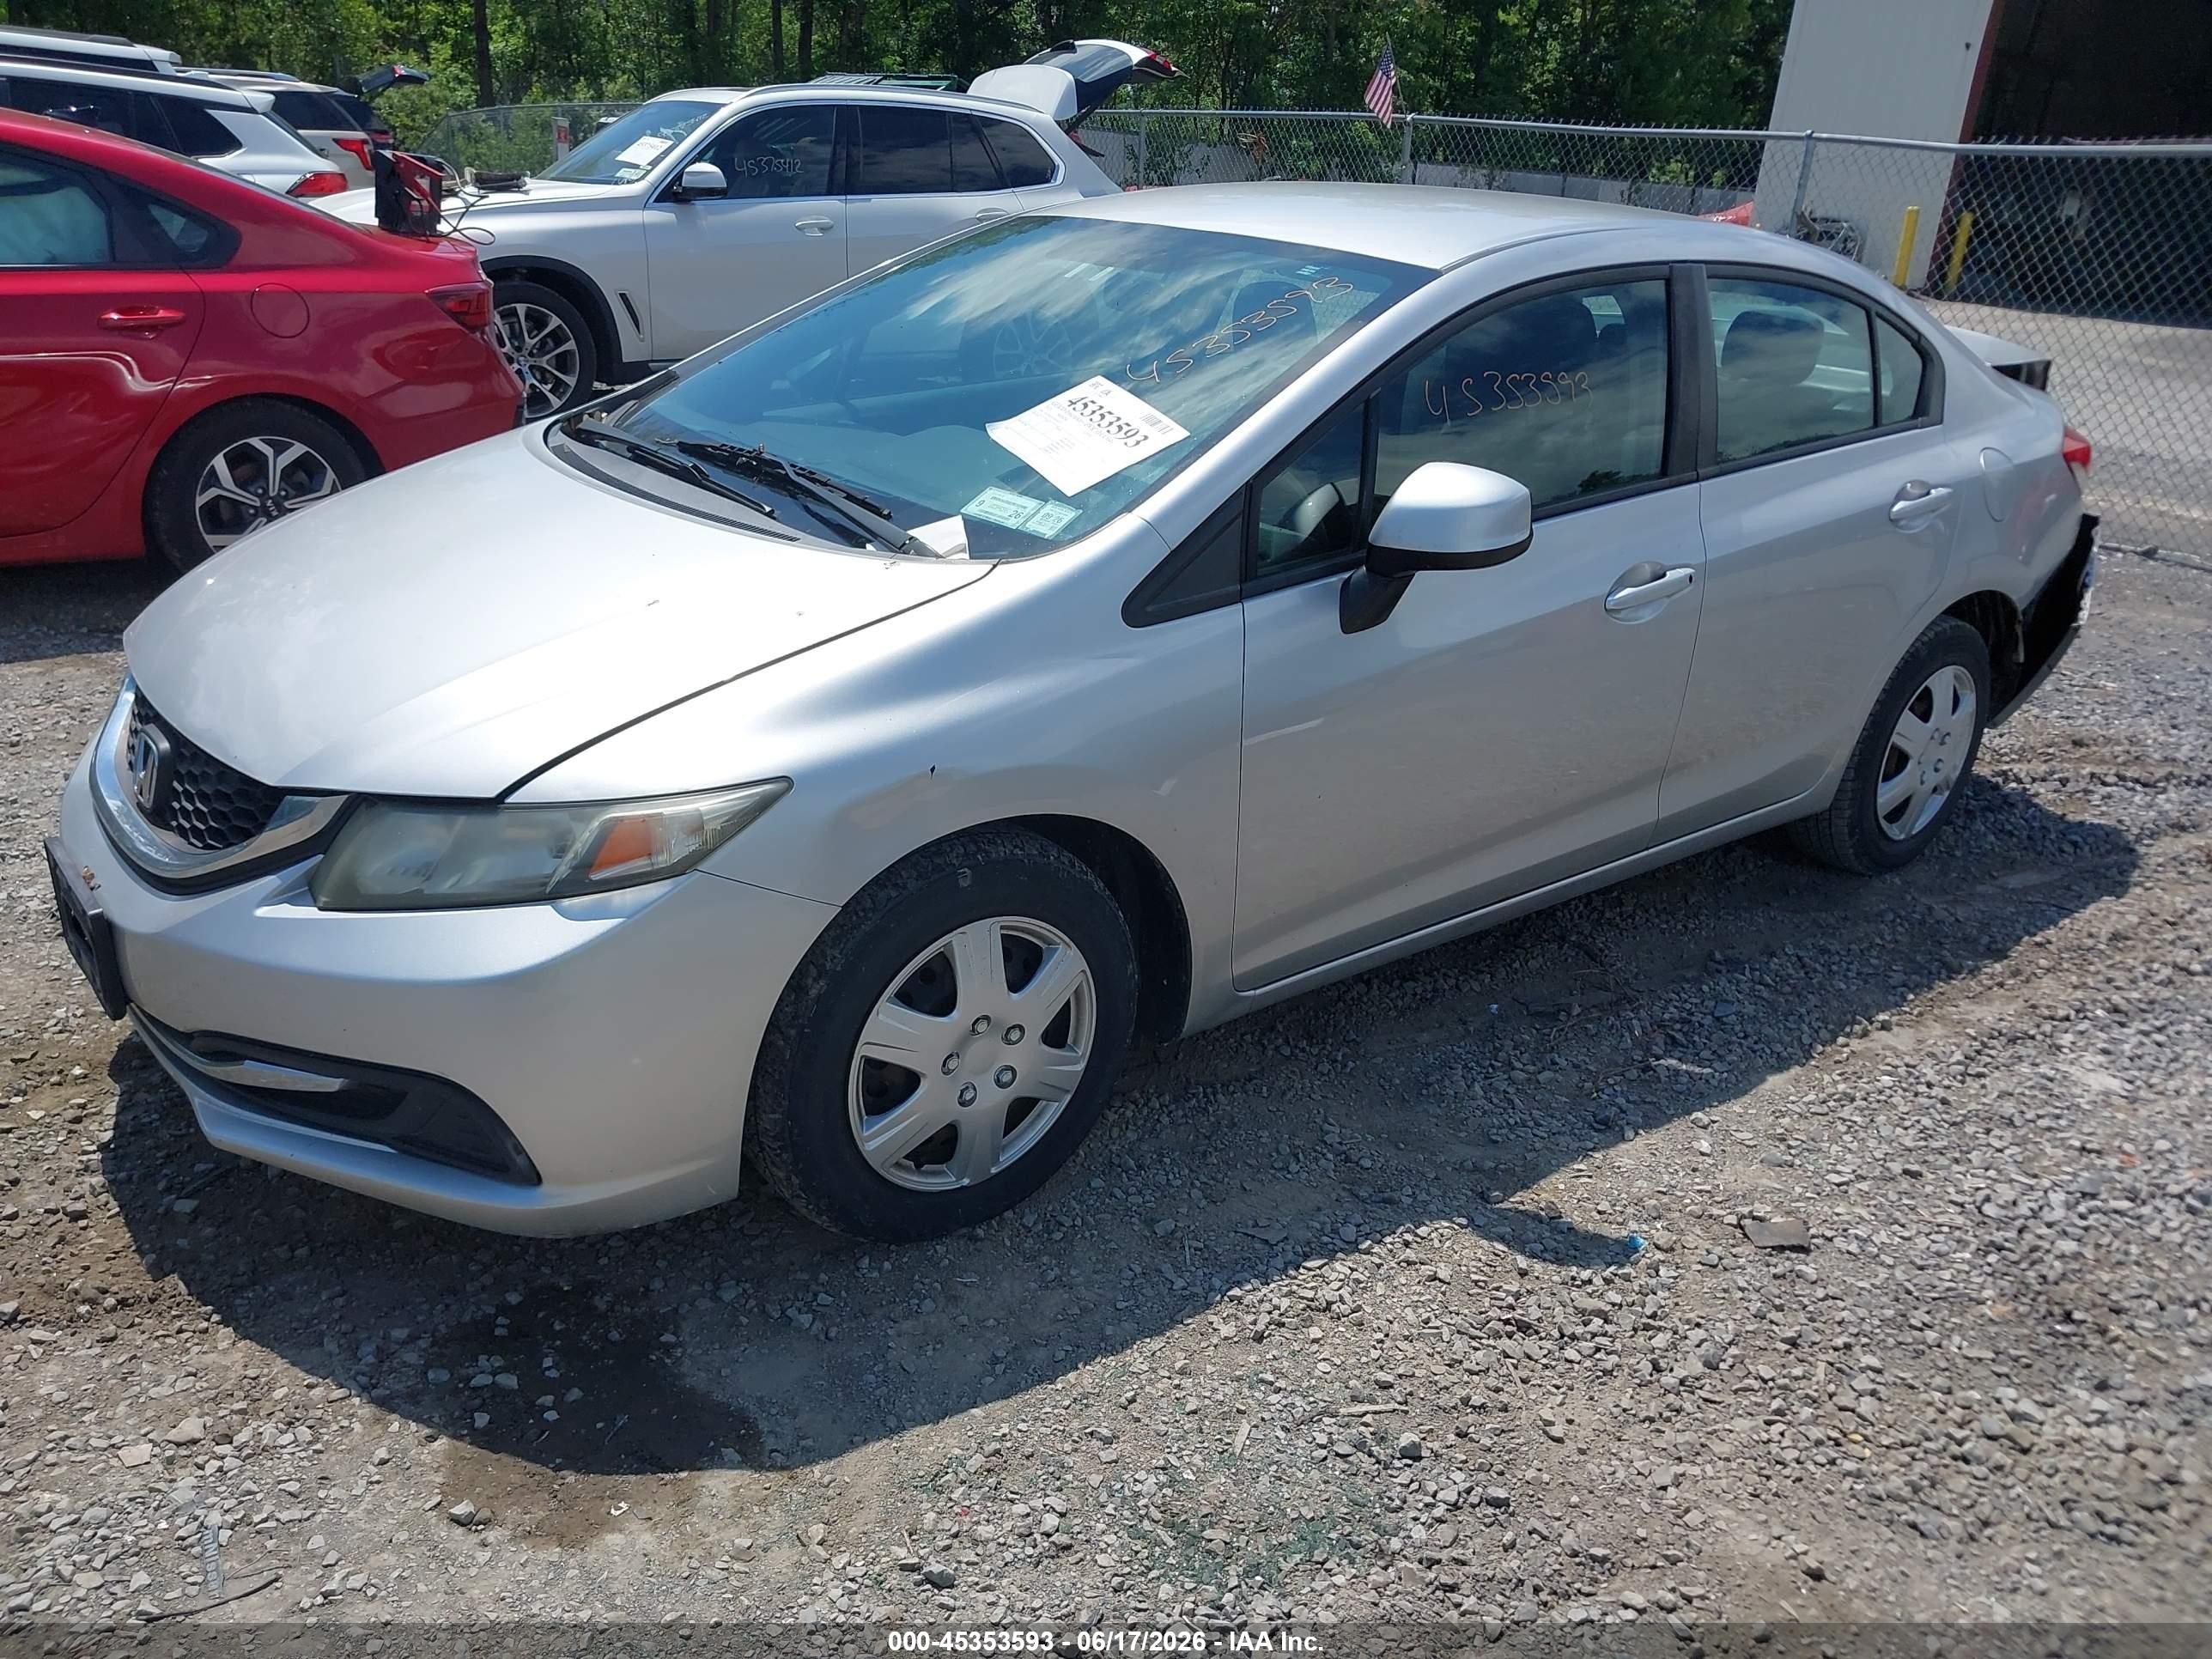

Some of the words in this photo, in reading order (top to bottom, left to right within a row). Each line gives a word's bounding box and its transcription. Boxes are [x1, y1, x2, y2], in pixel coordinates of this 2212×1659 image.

[1126, 276, 1354, 383] 45353593
[1066, 396, 1149, 448] 45353593
[1425, 371, 1594, 427] 45353593
[1008, 510, 1024, 520] 26
